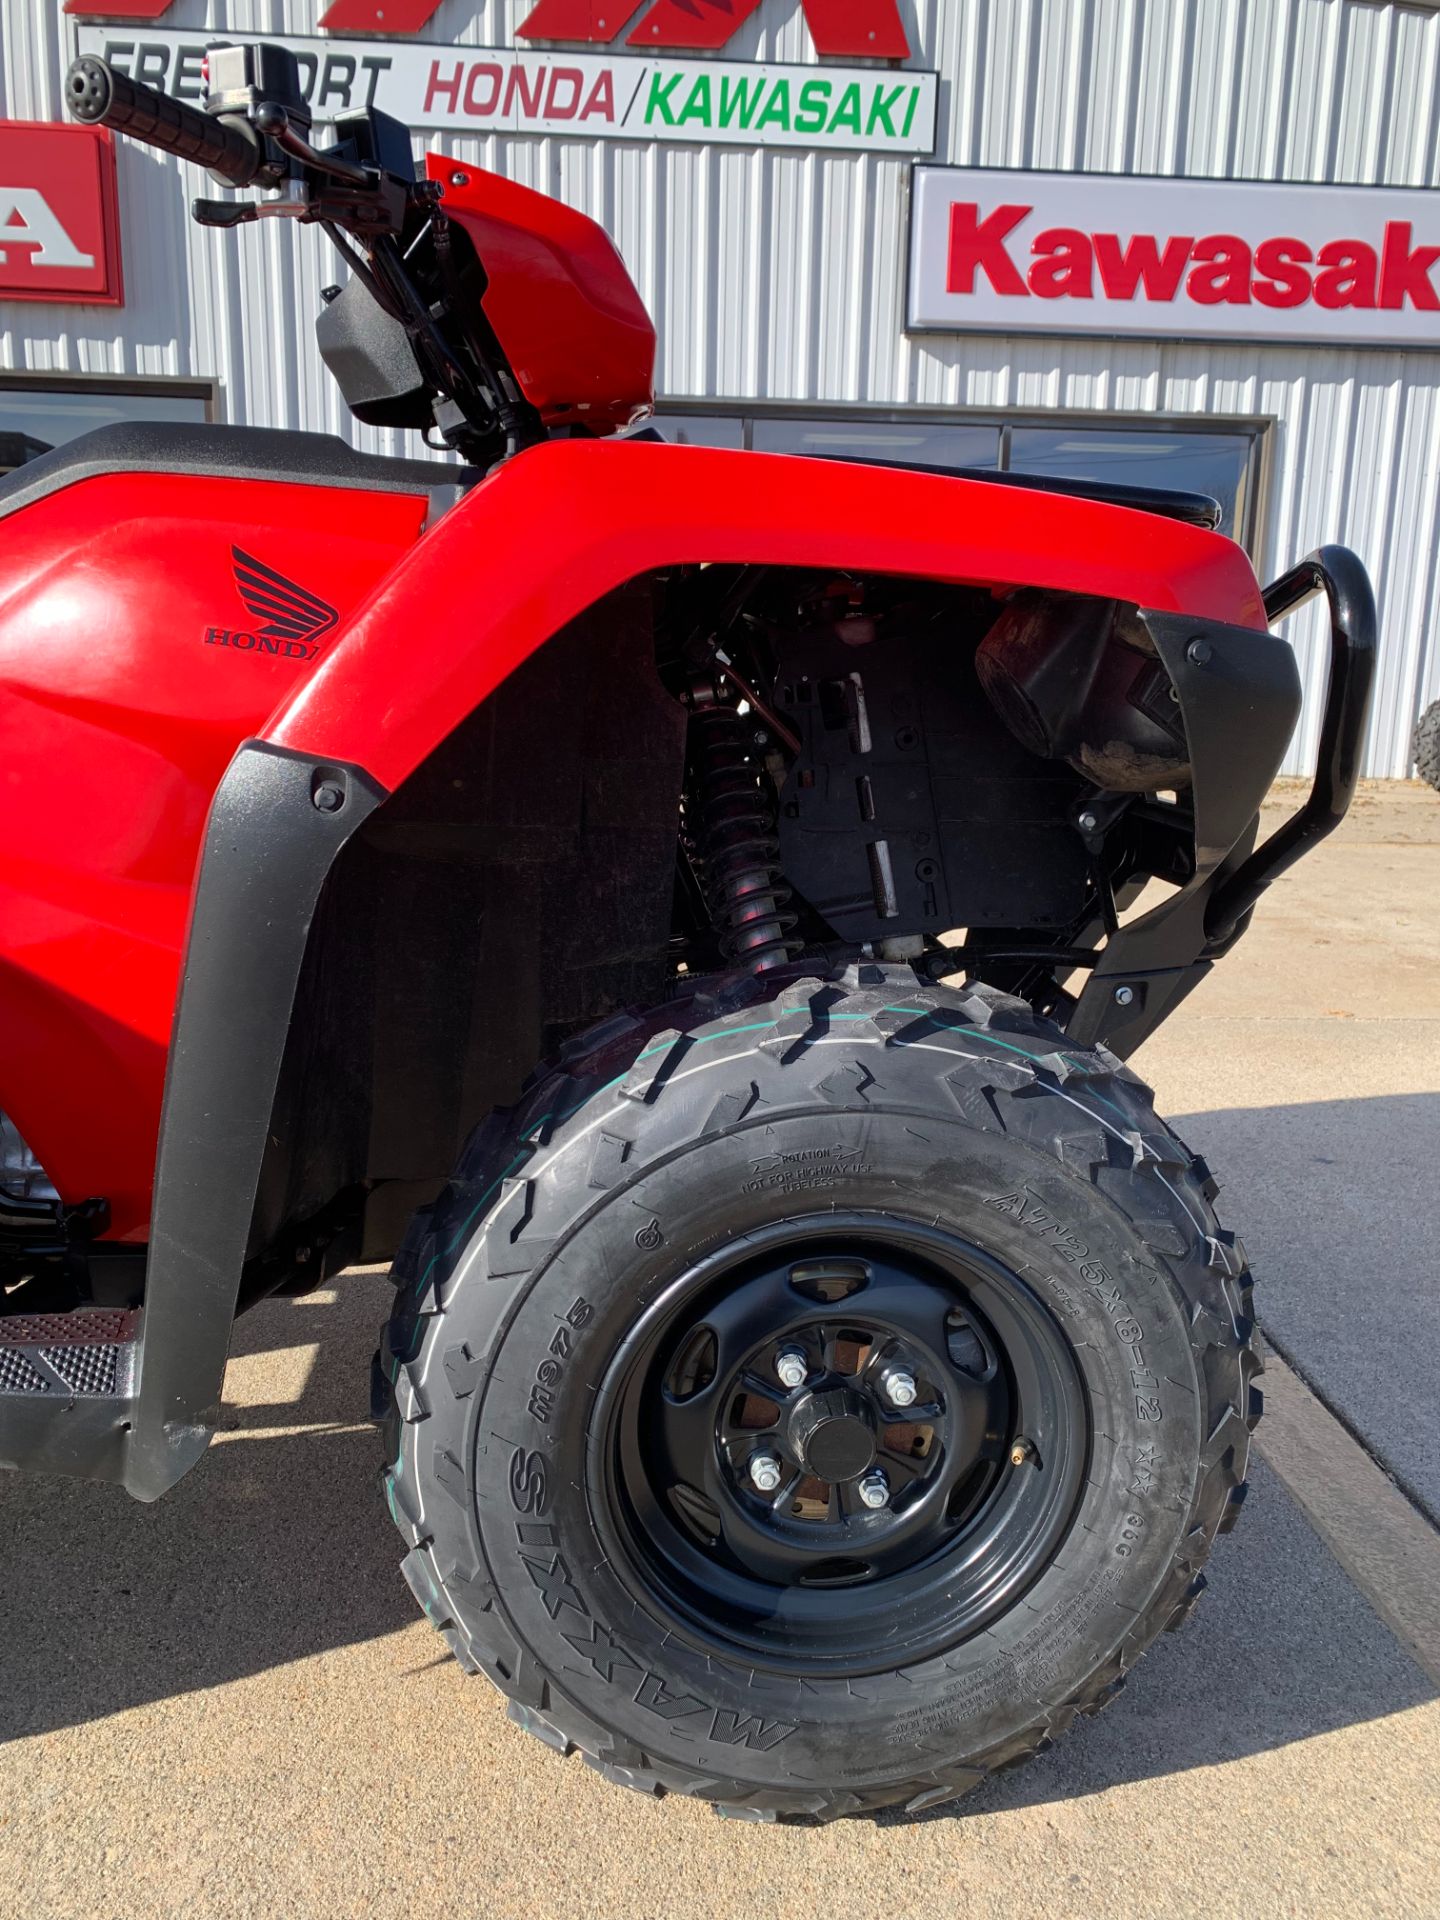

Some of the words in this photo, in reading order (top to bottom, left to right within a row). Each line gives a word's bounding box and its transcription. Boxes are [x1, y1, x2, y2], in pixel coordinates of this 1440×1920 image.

[103, 41, 393, 108] FRERT
[741, 1178, 765, 1194] NOT
[769, 1170, 793, 1184] FOR
[797, 1163, 849, 1179] HIGHWAY
[853, 1163, 875, 1174] USE
[781, 1148, 831, 1165] ROTATION
[780, 1176, 836, 1194] TUBELESS
[525, 1296, 596, 1423] M975
[508, 1446, 801, 1752] MAXXIS
